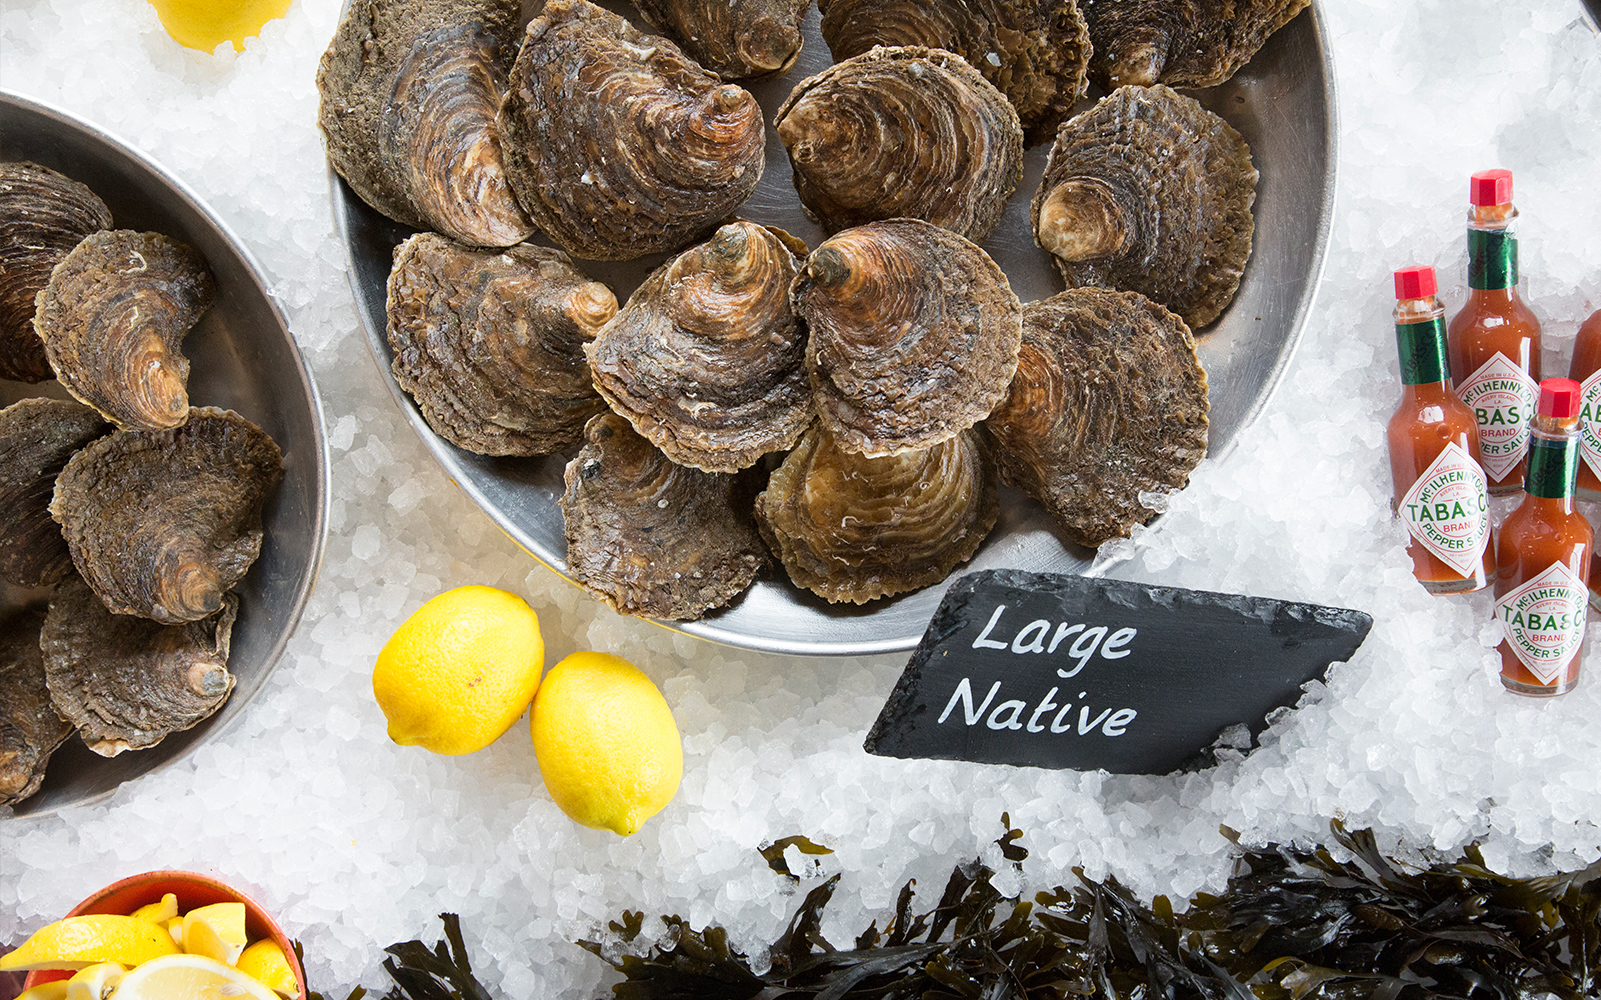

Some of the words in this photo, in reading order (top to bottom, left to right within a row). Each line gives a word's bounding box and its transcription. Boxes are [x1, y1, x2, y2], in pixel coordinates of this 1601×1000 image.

[1476, 400, 1537, 426] BASC
[1481, 428, 1516, 437] BRAND
[1502, 421, 1531, 454] SAUCE
[1422, 523, 1465, 549] PEPPER
[1443, 520, 1476, 533] BRAND
[972, 604, 1138, 679] Large
[1513, 628, 1549, 658] PEPPER
[1532, 634, 1567, 642] BRAND
[938, 677, 1139, 738] Native
